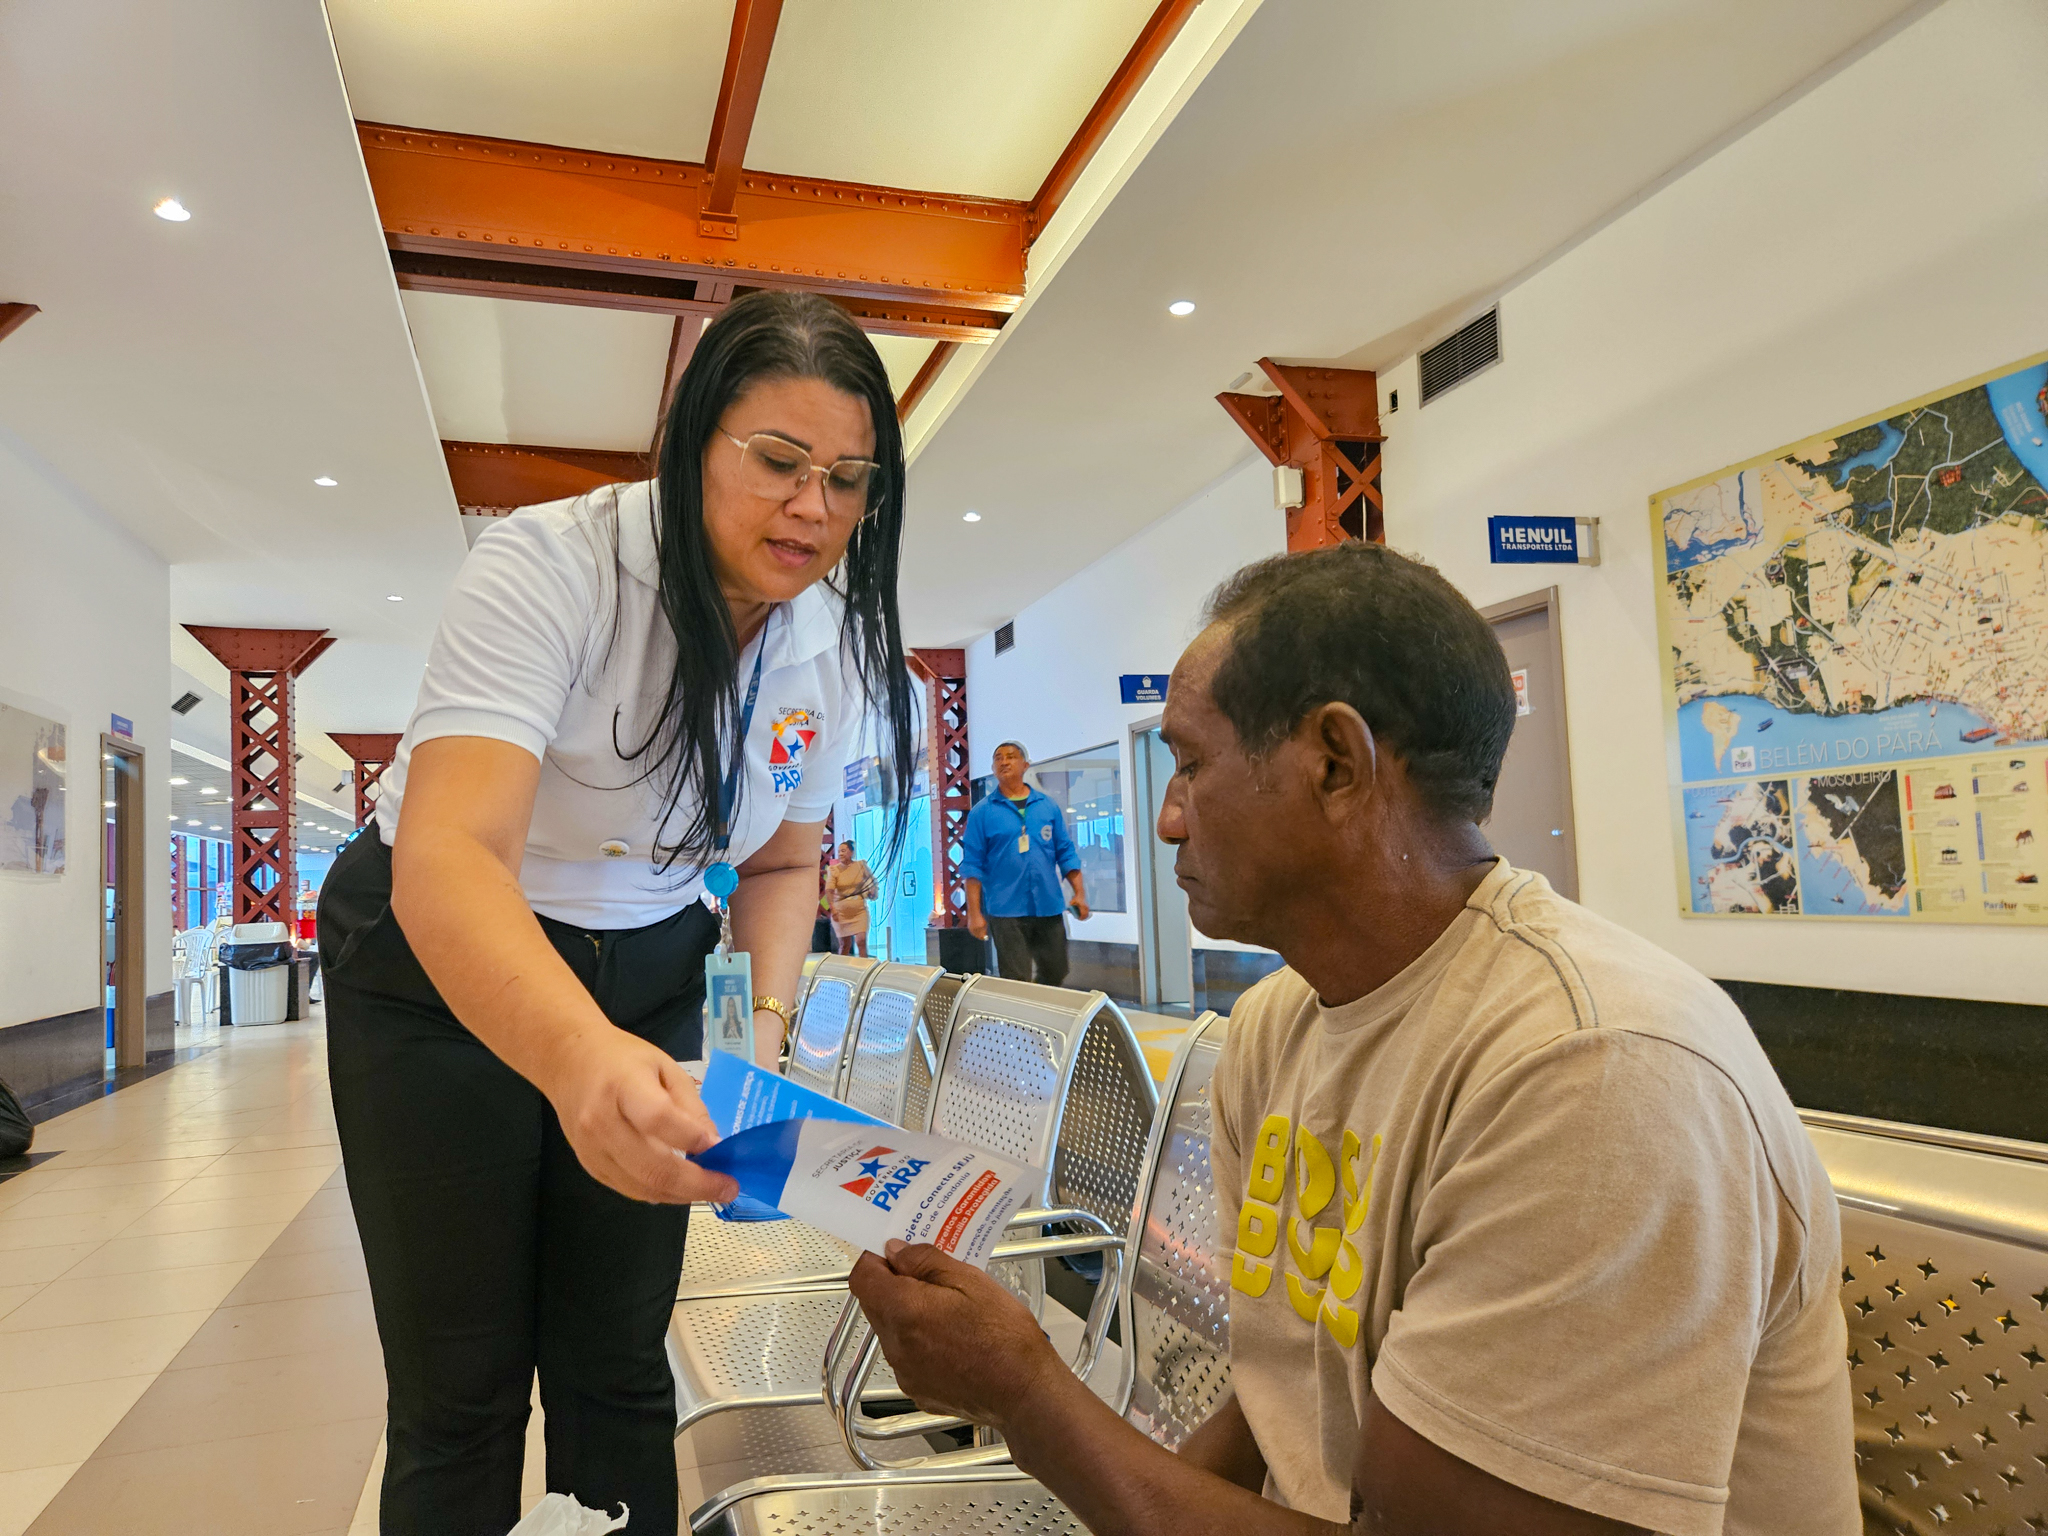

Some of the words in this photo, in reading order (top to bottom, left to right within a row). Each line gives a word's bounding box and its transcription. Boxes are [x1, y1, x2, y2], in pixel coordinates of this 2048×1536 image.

[1500, 527, 1572, 543] HENVIL
[1759, 738, 1829, 769] BELÉM
[1836, 736, 1869, 761] DO
[1877, 721, 1943, 755] PARÁ
[771, 769, 803, 793] PAR
[1817, 769, 1891, 788] MOSQUEIRO
[832, 1147, 864, 1172] JUSTIÇA
[865, 1165, 898, 1202] GOVERNO
[905, 1212, 923, 1242] ojeto
[920, 1172, 955, 1210] Conecta
[952, 1152, 976, 1172] SEJU
[964, 1178, 999, 1217] Protegida
[920, 1224, 932, 1238] Elo
[929, 1210, 939, 1222] de
[936, 1171, 971, 1209] Cidadania
[984, 1187, 1013, 1222] orientação
[935, 1215, 959, 1251] Direitos
[977, 1225, 993, 1251] acesso
